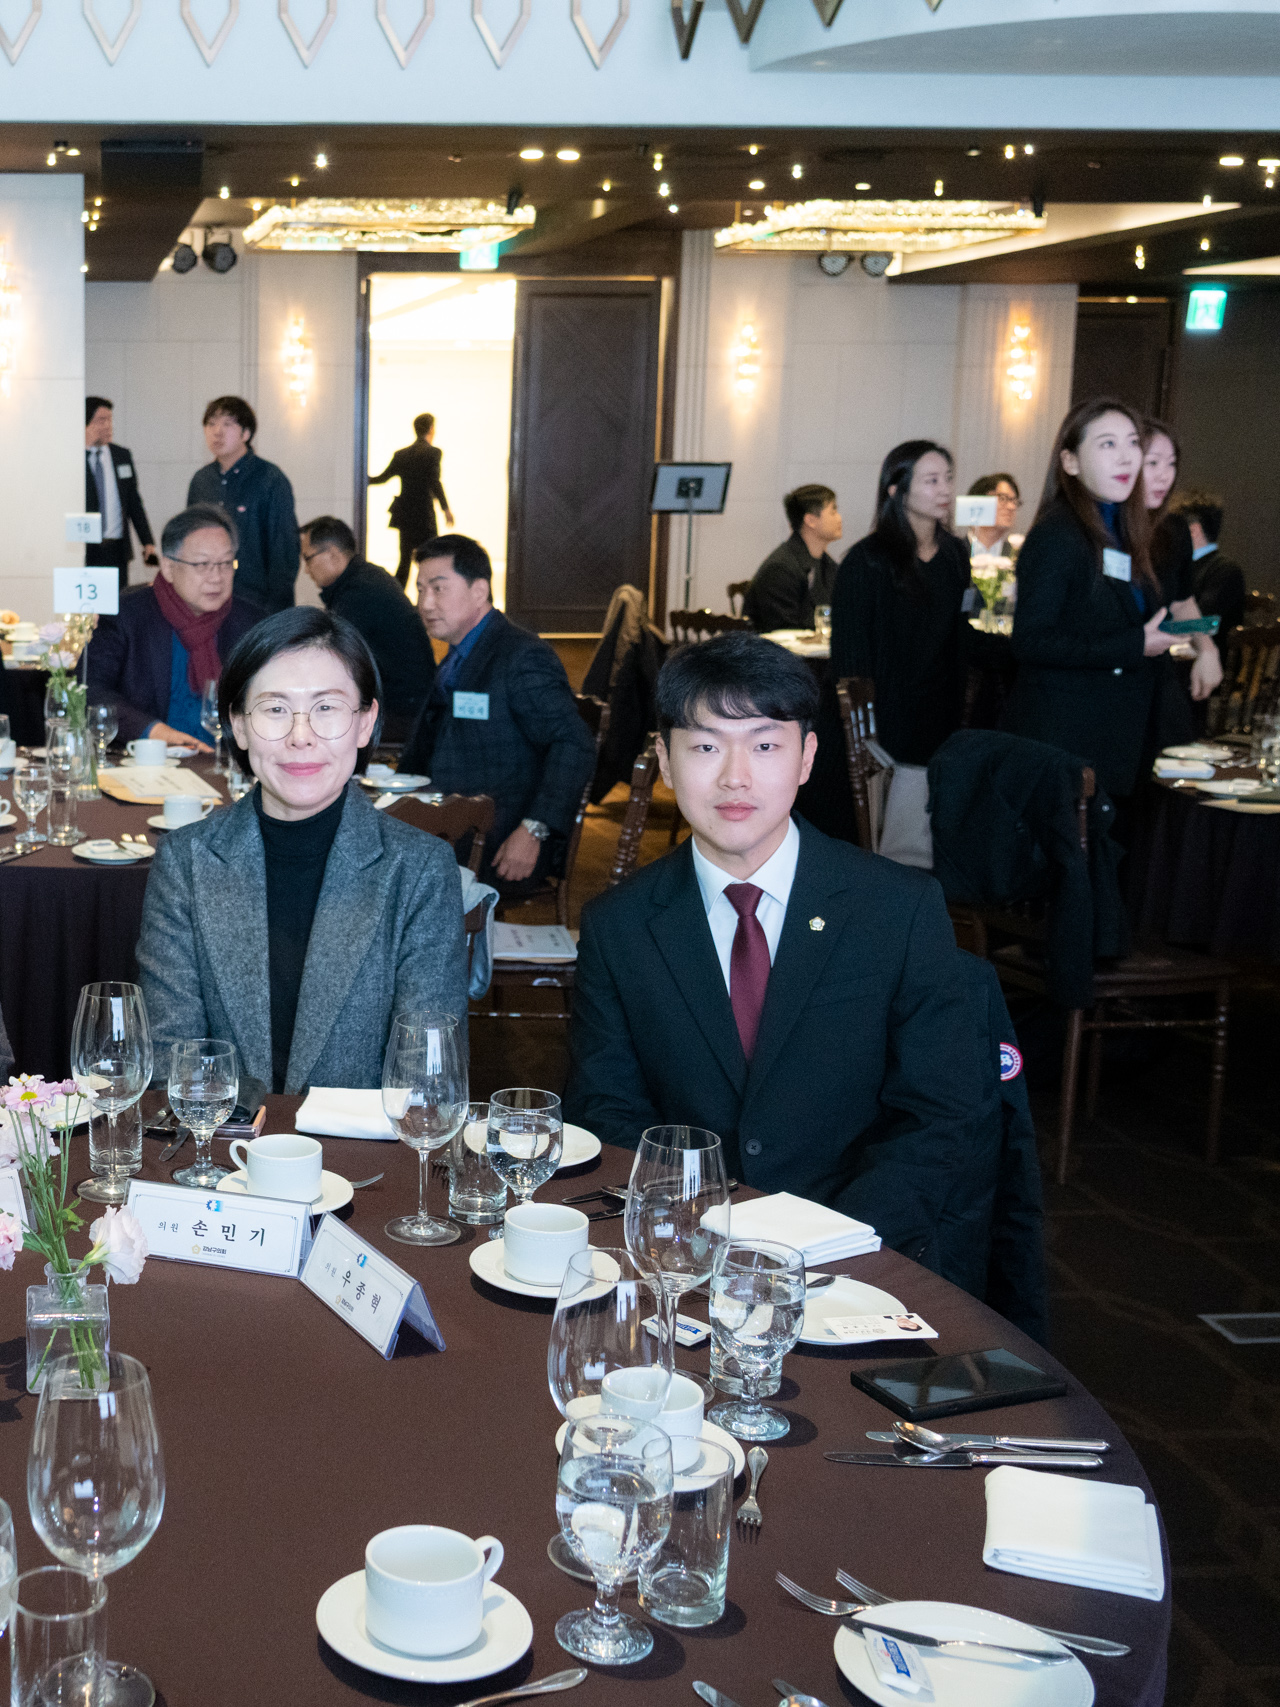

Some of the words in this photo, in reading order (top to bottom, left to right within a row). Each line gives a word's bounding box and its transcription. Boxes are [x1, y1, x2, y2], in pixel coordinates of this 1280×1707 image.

[75, 584, 98, 600] 13
[158, 1221, 179, 1233] 의원
[191, 1219, 266, 1247] 손민기
[342, 1269, 382, 1315] 우종혁
